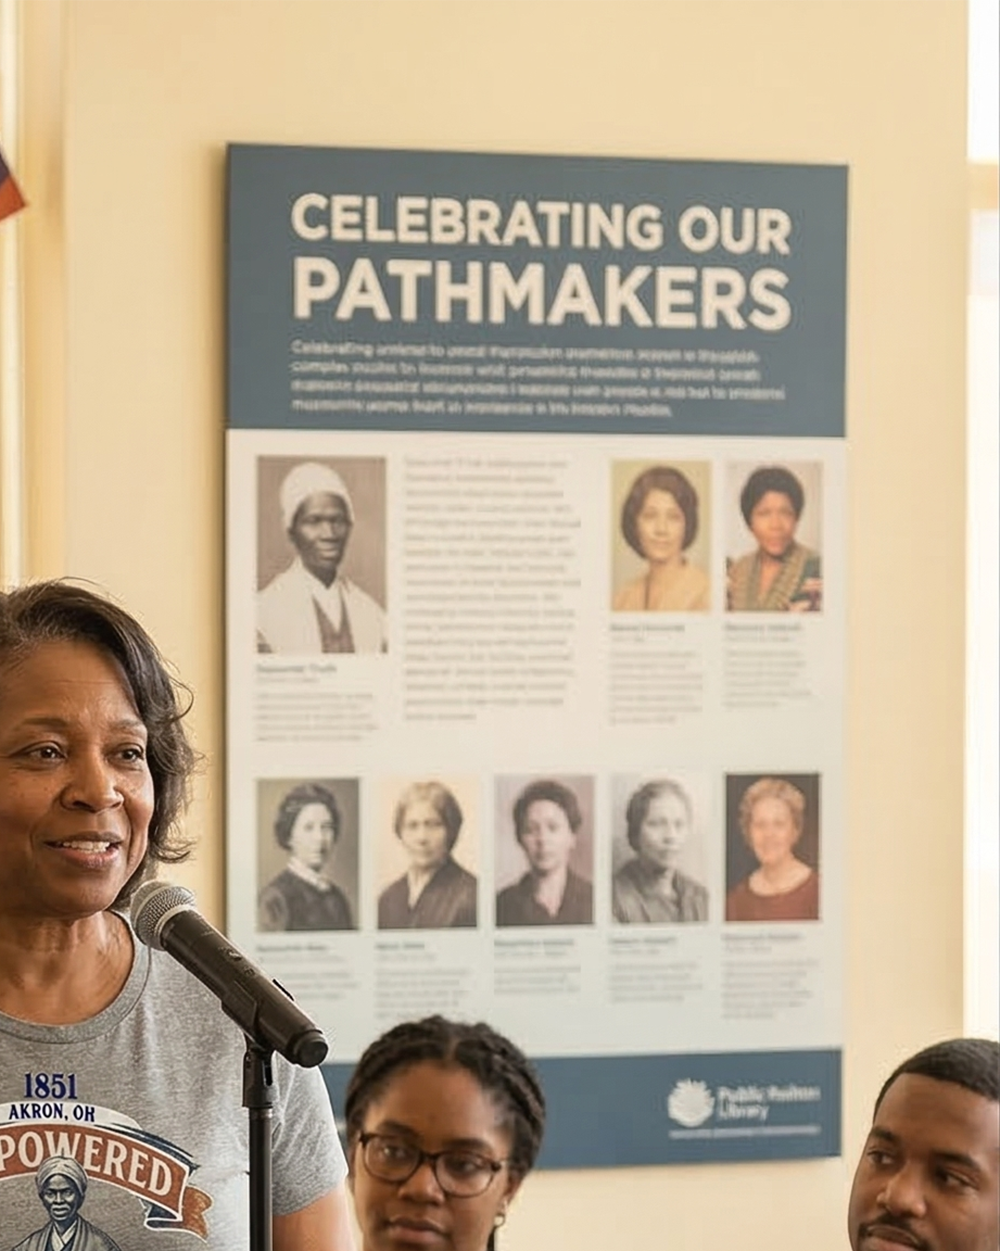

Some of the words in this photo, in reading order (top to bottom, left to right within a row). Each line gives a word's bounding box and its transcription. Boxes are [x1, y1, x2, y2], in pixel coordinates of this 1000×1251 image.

[291, 192, 663, 251] CELEBRATING
[679, 206, 791, 255] OUR
[294, 256, 791, 331] PATHMAKERS
[24, 1072, 77, 1099] 1851
[9, 1102, 68, 1121] AKRON,
[73, 1104, 95, 1122] OH
